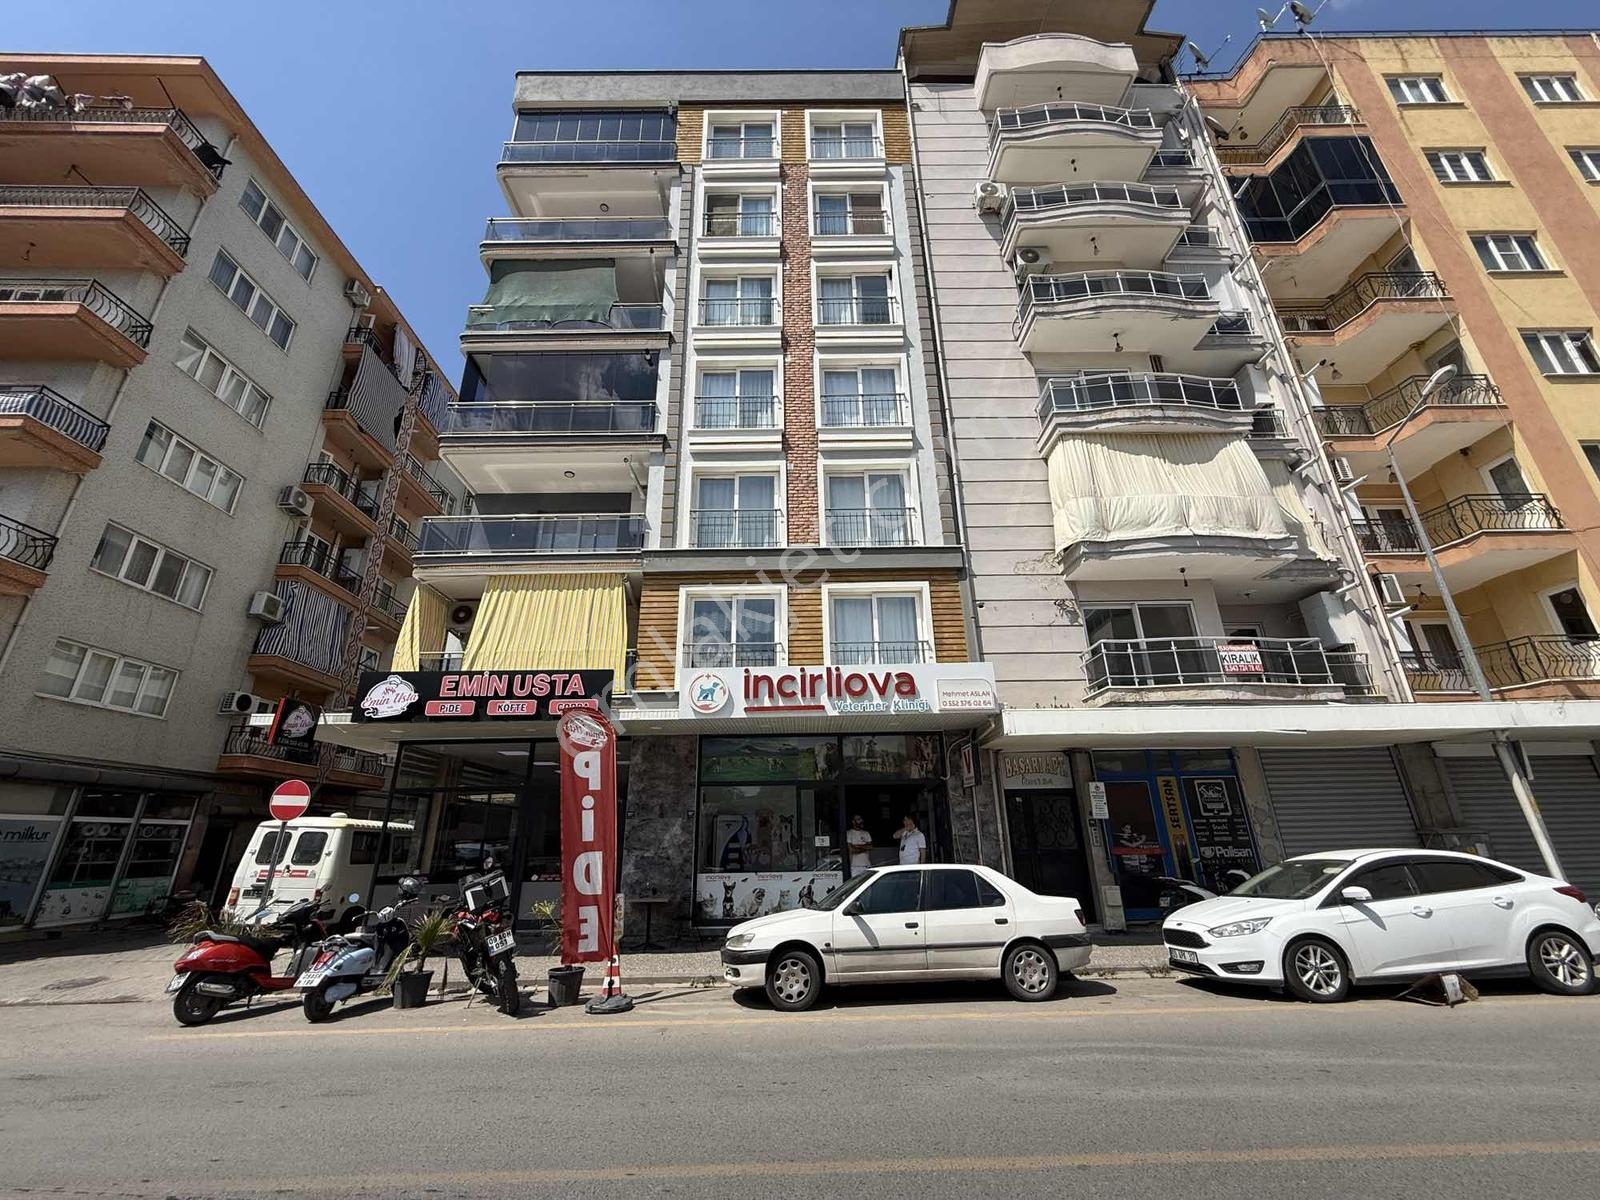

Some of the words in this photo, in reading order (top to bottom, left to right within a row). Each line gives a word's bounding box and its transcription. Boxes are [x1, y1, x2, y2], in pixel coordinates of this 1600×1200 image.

[1220, 653, 1260, 664] KIRALIK
[439, 670, 509, 697] EMİN
[512, 673, 585, 696] USTA
[743, 666, 917, 699] incirliova
[362, 695, 390, 708] Emin
[393, 692, 417, 703] Usta
[497, 701, 526, 713] KÖFTE
[834, 699, 888, 713] Veteriner
[893, 698, 929, 713] Kliniği
[1162, 779, 1181, 829] SERTSAN
[4, 825, 51, 841] milkur
[1215, 846, 1253, 858] Polisan
